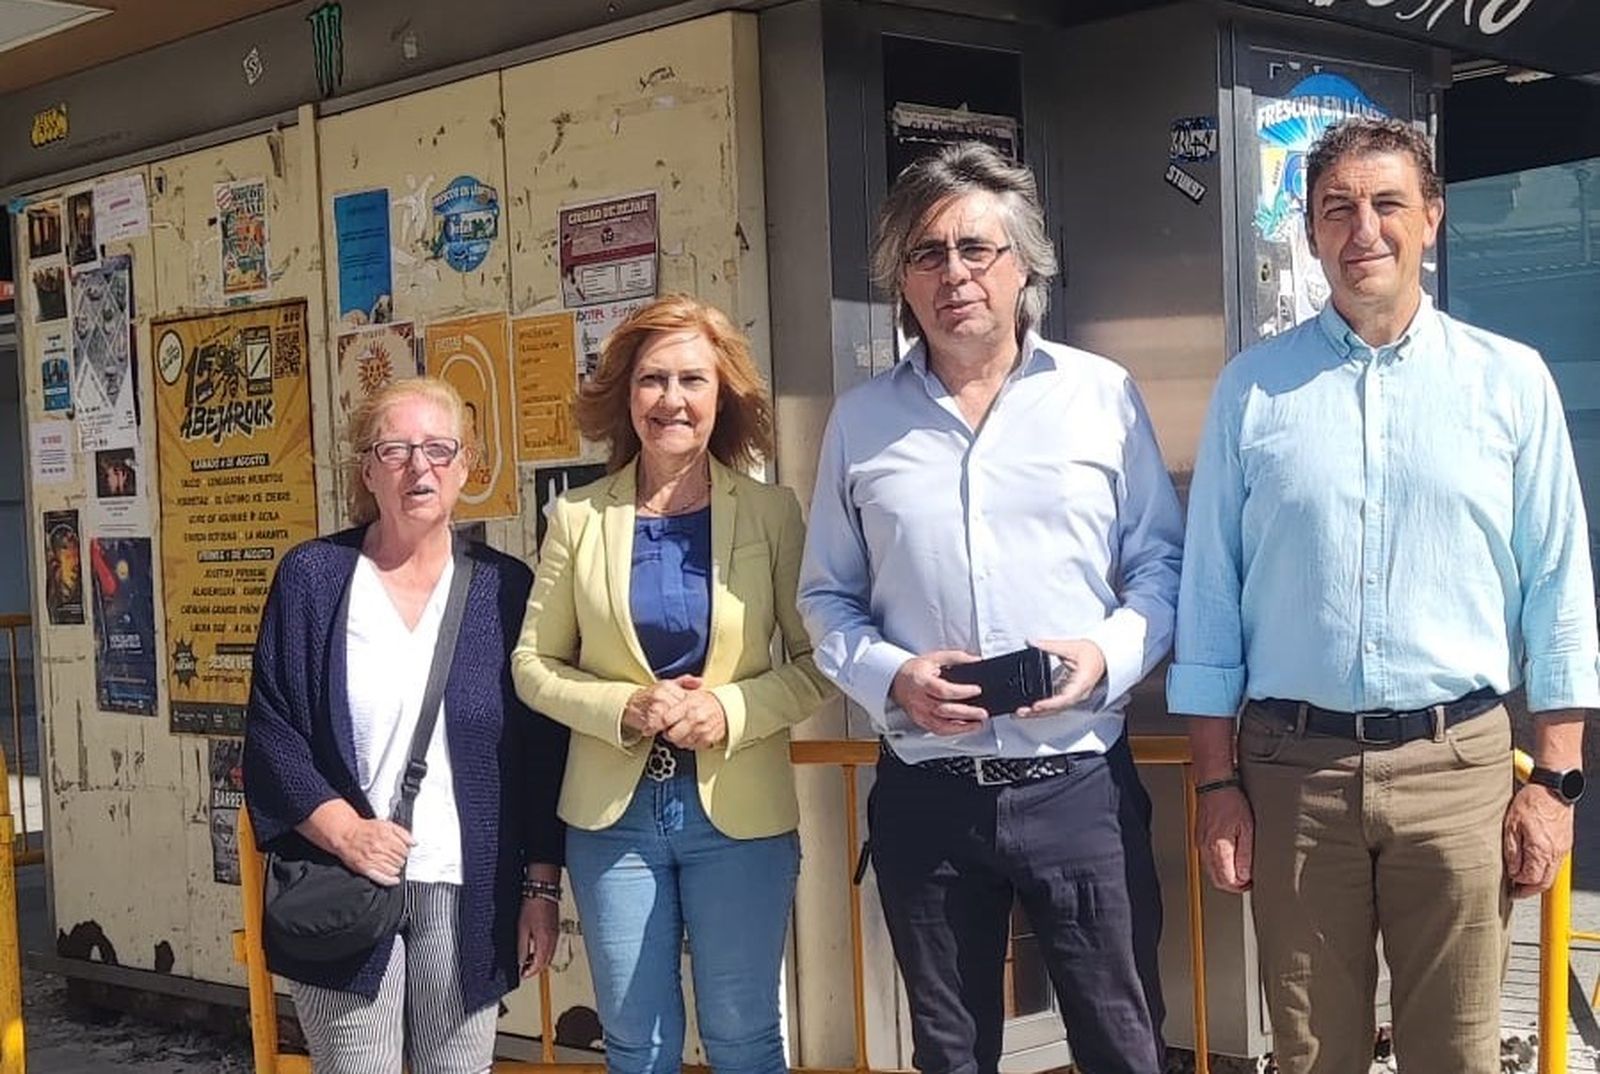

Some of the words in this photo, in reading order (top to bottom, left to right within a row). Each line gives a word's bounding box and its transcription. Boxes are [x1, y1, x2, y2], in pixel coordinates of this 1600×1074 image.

[1257, 97, 1319, 125] FRESCOR
[180, 397, 274, 446] ABEJAROCK
[236, 454, 266, 467] AGOSTO
